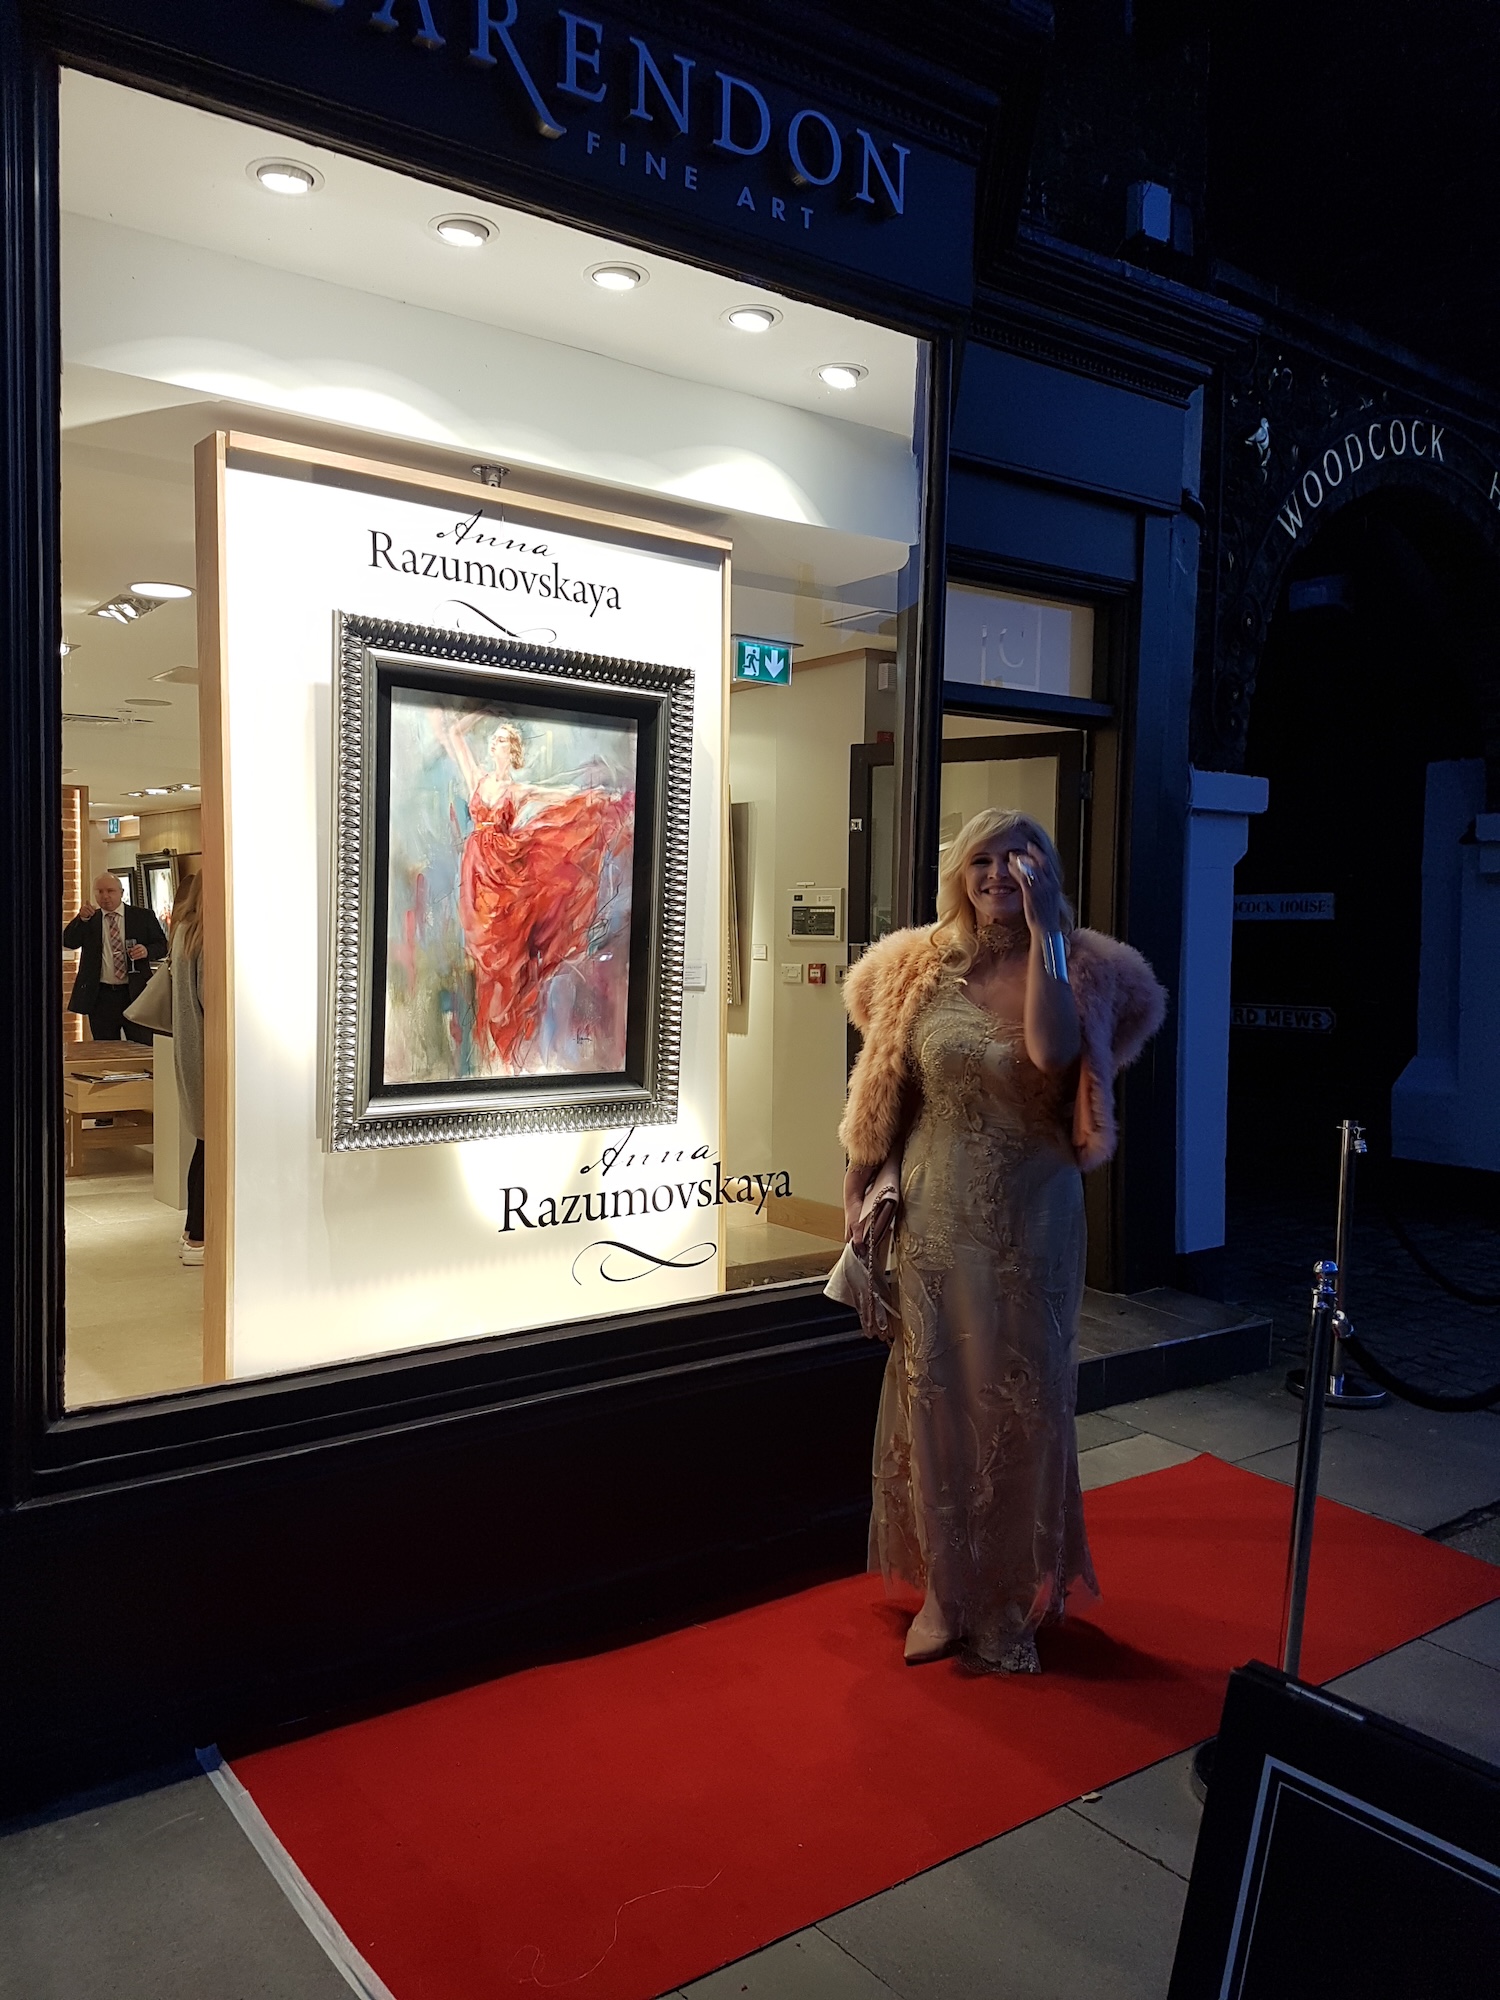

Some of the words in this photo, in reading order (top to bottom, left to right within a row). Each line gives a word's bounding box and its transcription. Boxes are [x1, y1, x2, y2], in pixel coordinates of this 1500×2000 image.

[306, 0, 912, 215] RENDON
[586, 130, 699, 191] FINE
[736, 185, 815, 230] ART
[1276, 418, 1445, 540] WOODCOCK
[366, 528, 623, 618] Razumovskaya
[436, 508, 557, 557] Anna
[1265, 1009, 1323, 1028] MEWS
[580, 1126, 719, 1177] Anna
[497, 1161, 794, 1233] Razumovskaya
